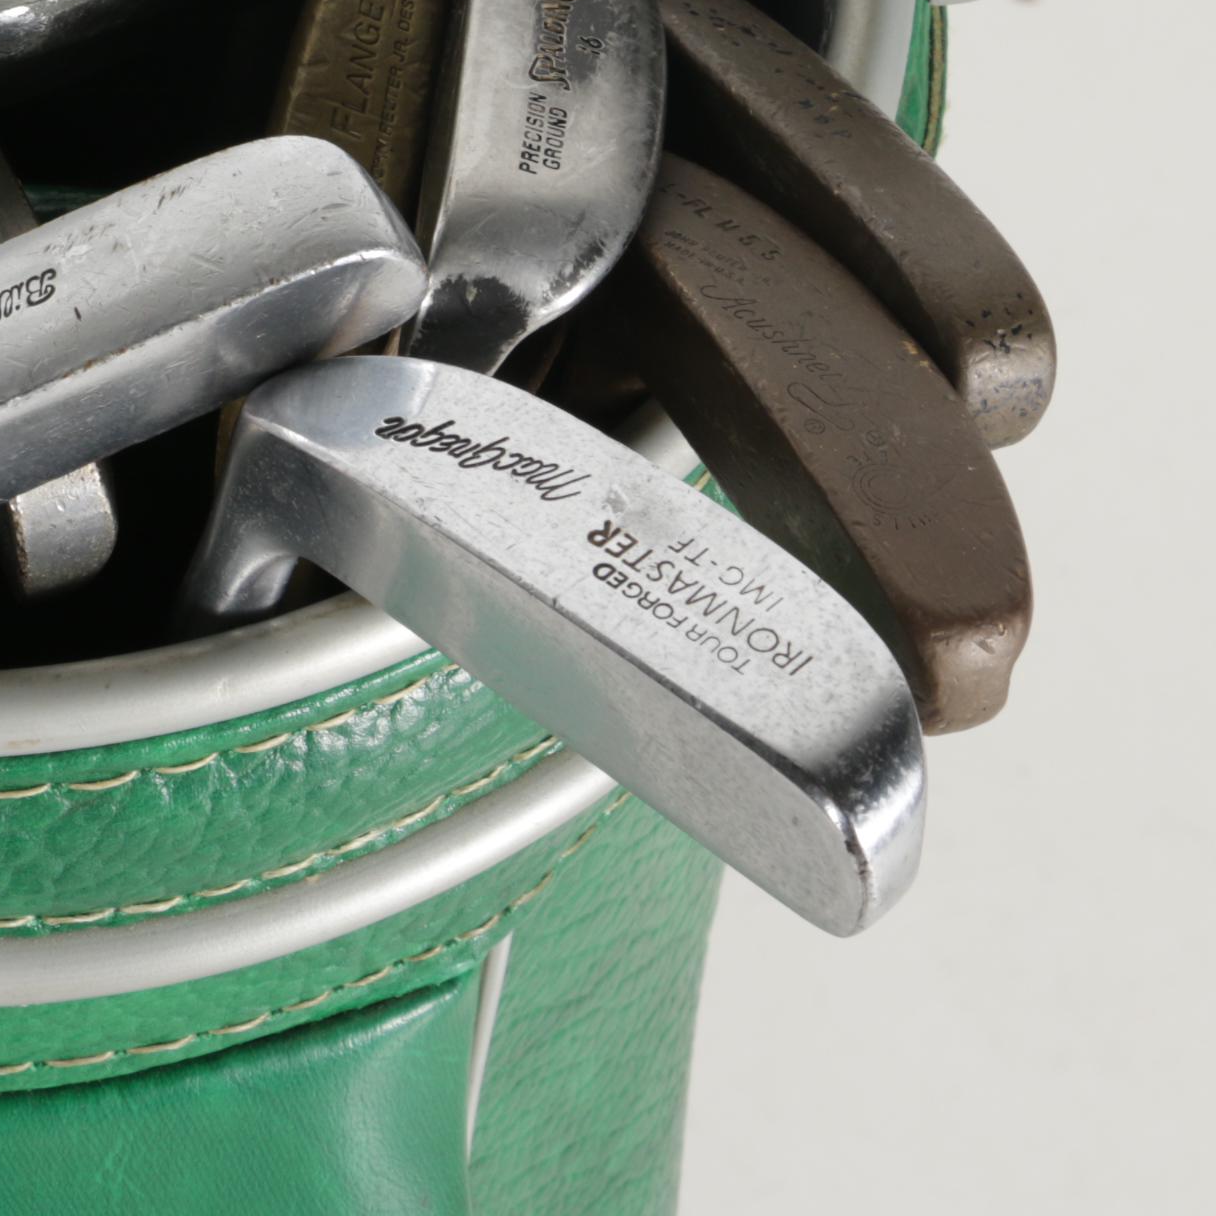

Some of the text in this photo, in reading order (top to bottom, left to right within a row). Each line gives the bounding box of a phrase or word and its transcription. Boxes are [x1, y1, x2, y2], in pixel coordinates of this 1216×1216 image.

[518, 92, 547, 175] PRECISION
[543, 107, 569, 171] GROUND
[374, 416, 591, 502] MacGregor
[587, 519, 814, 676] IRONMASTER
[592, 562, 751, 675] TOUR FORGED
